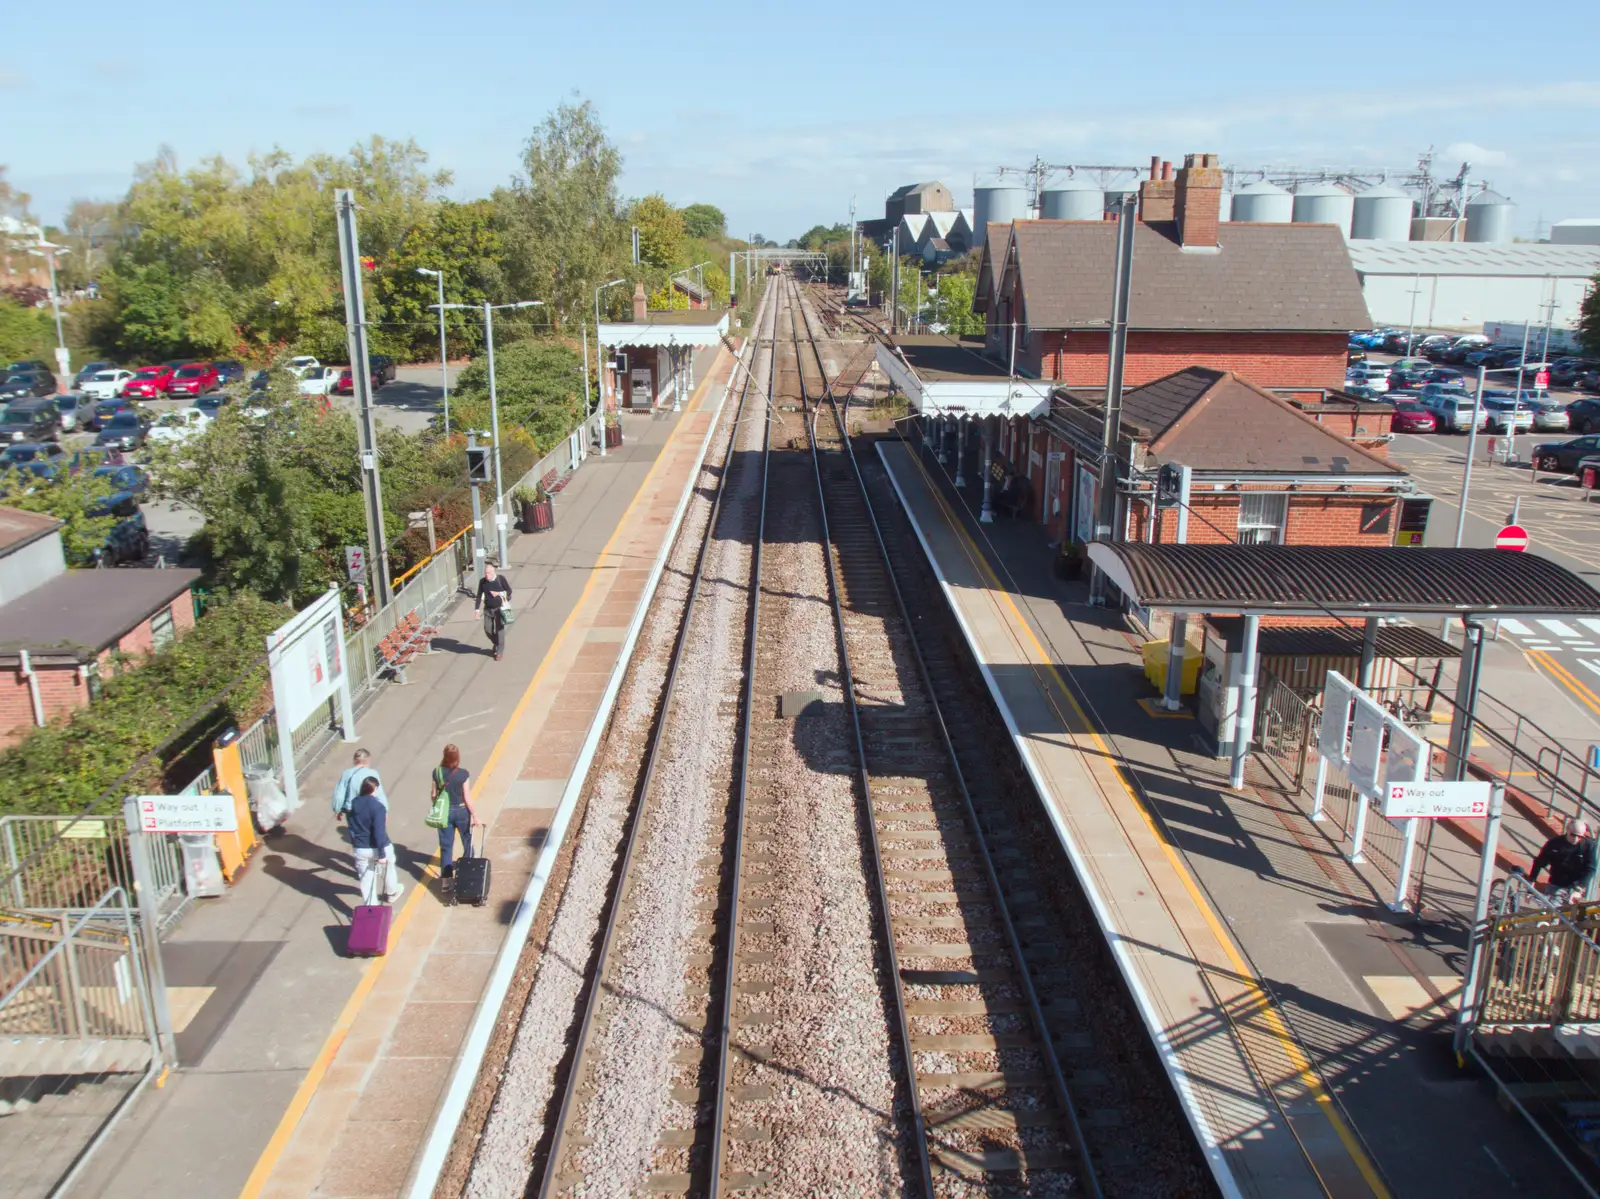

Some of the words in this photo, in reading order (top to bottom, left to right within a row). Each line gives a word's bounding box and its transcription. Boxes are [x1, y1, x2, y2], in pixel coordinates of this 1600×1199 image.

[1406, 789, 1425, 798] Way
[158, 803, 178, 812] Way
[1432, 804, 1452, 814] Way
[1455, 805, 1471, 813] out
[159, 818, 201, 828] Platform
